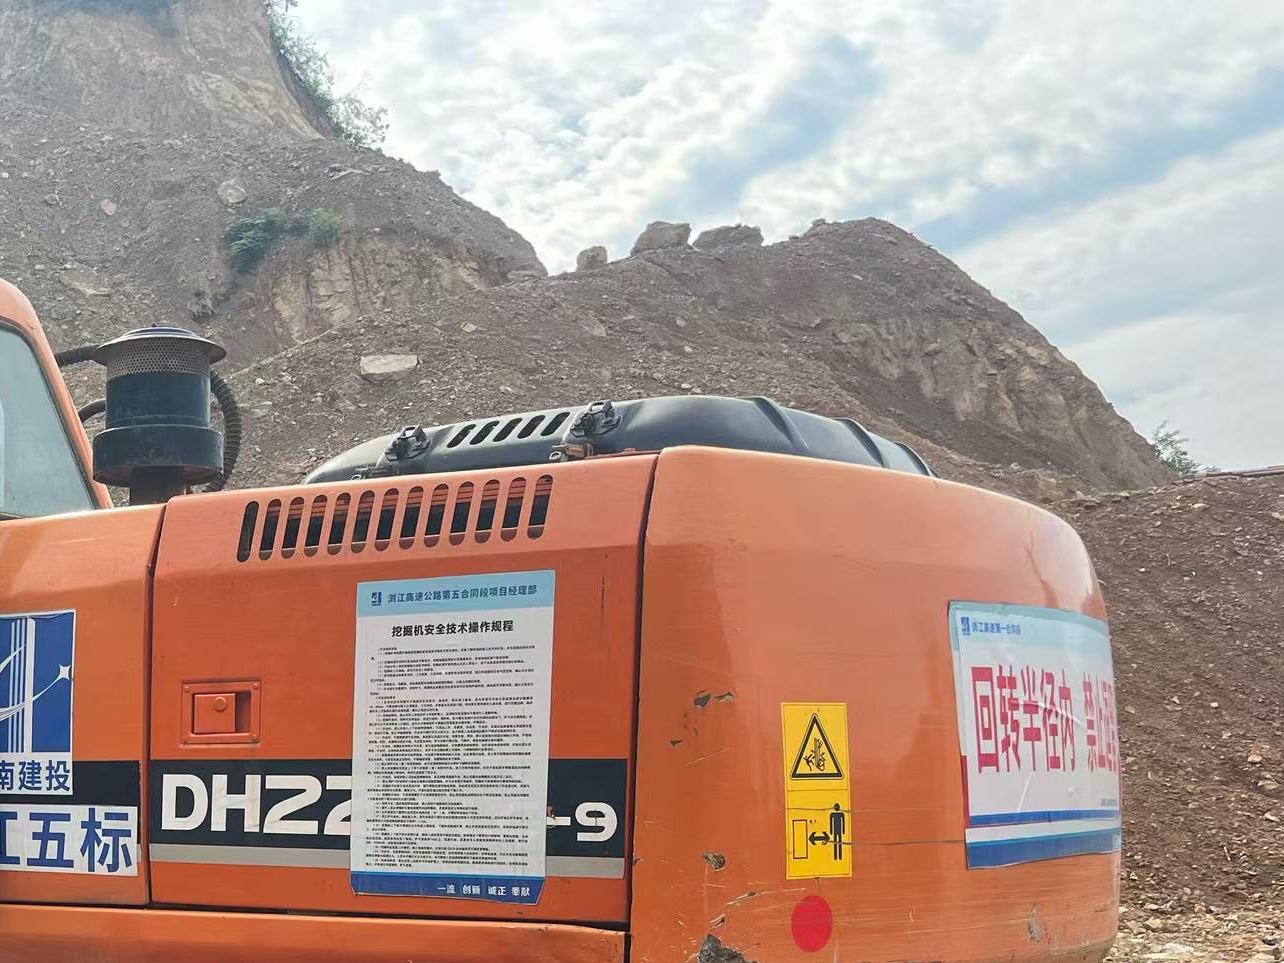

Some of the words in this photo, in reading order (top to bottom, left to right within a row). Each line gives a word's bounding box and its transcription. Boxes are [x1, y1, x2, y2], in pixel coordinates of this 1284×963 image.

[391, 620, 514, 638] 挖掘机安全技术操作规程
[971, 663, 1076, 774] 回转半径内
